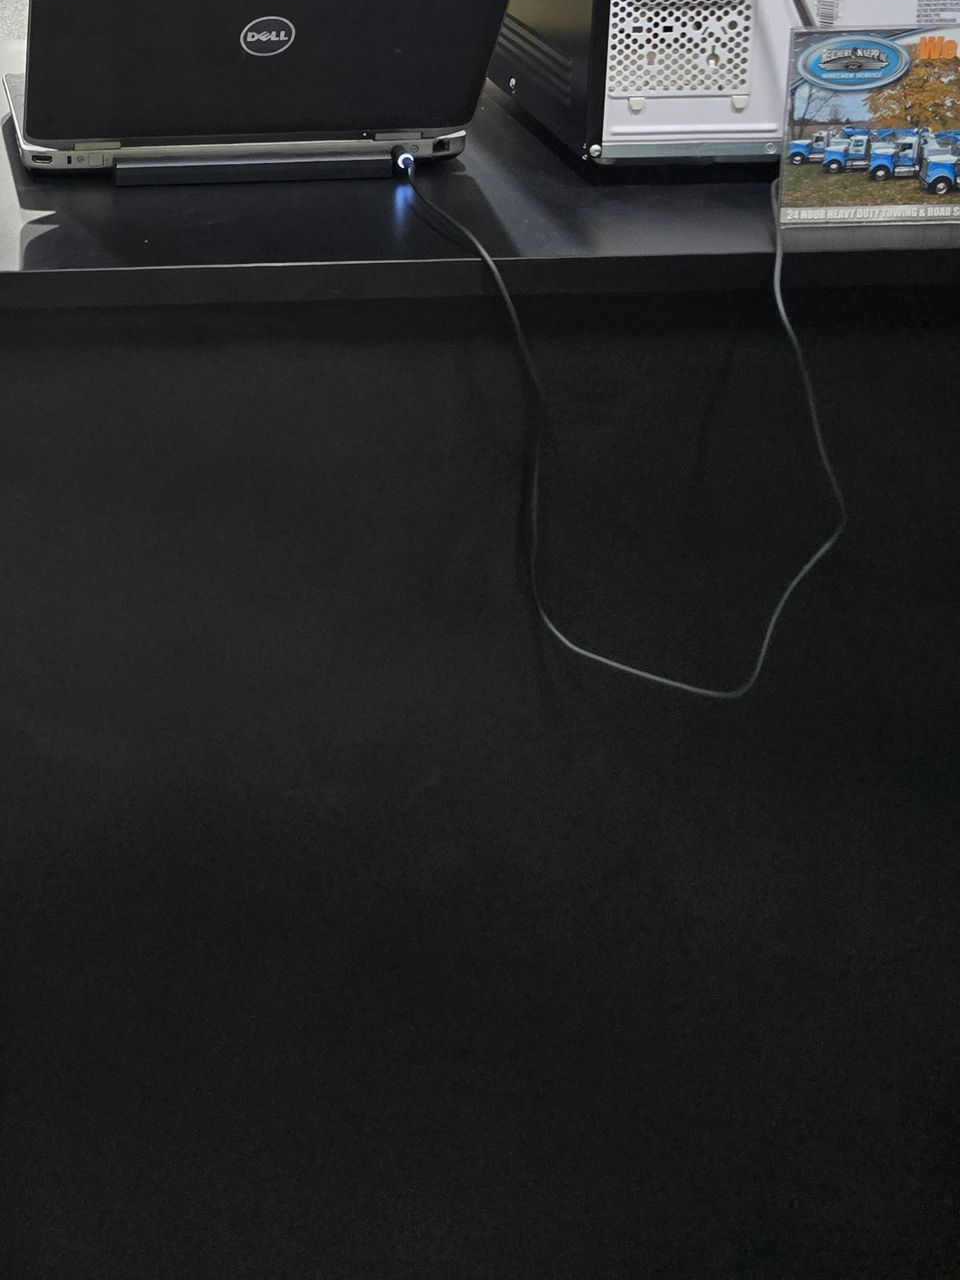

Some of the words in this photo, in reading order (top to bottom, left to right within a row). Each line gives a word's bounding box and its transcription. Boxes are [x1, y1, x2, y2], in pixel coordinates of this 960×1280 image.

[246, 30, 289, 42] DELL
[919, 35, 958, 61] We
[787, 209, 799, 220] 24
[800, 209, 825, 220] HOUR
[827, 208, 855, 219] HEAVY
[856, 208, 882, 219] DUTY
[881, 207, 917, 219] TOWING
[927, 206, 951, 217] ROAD
